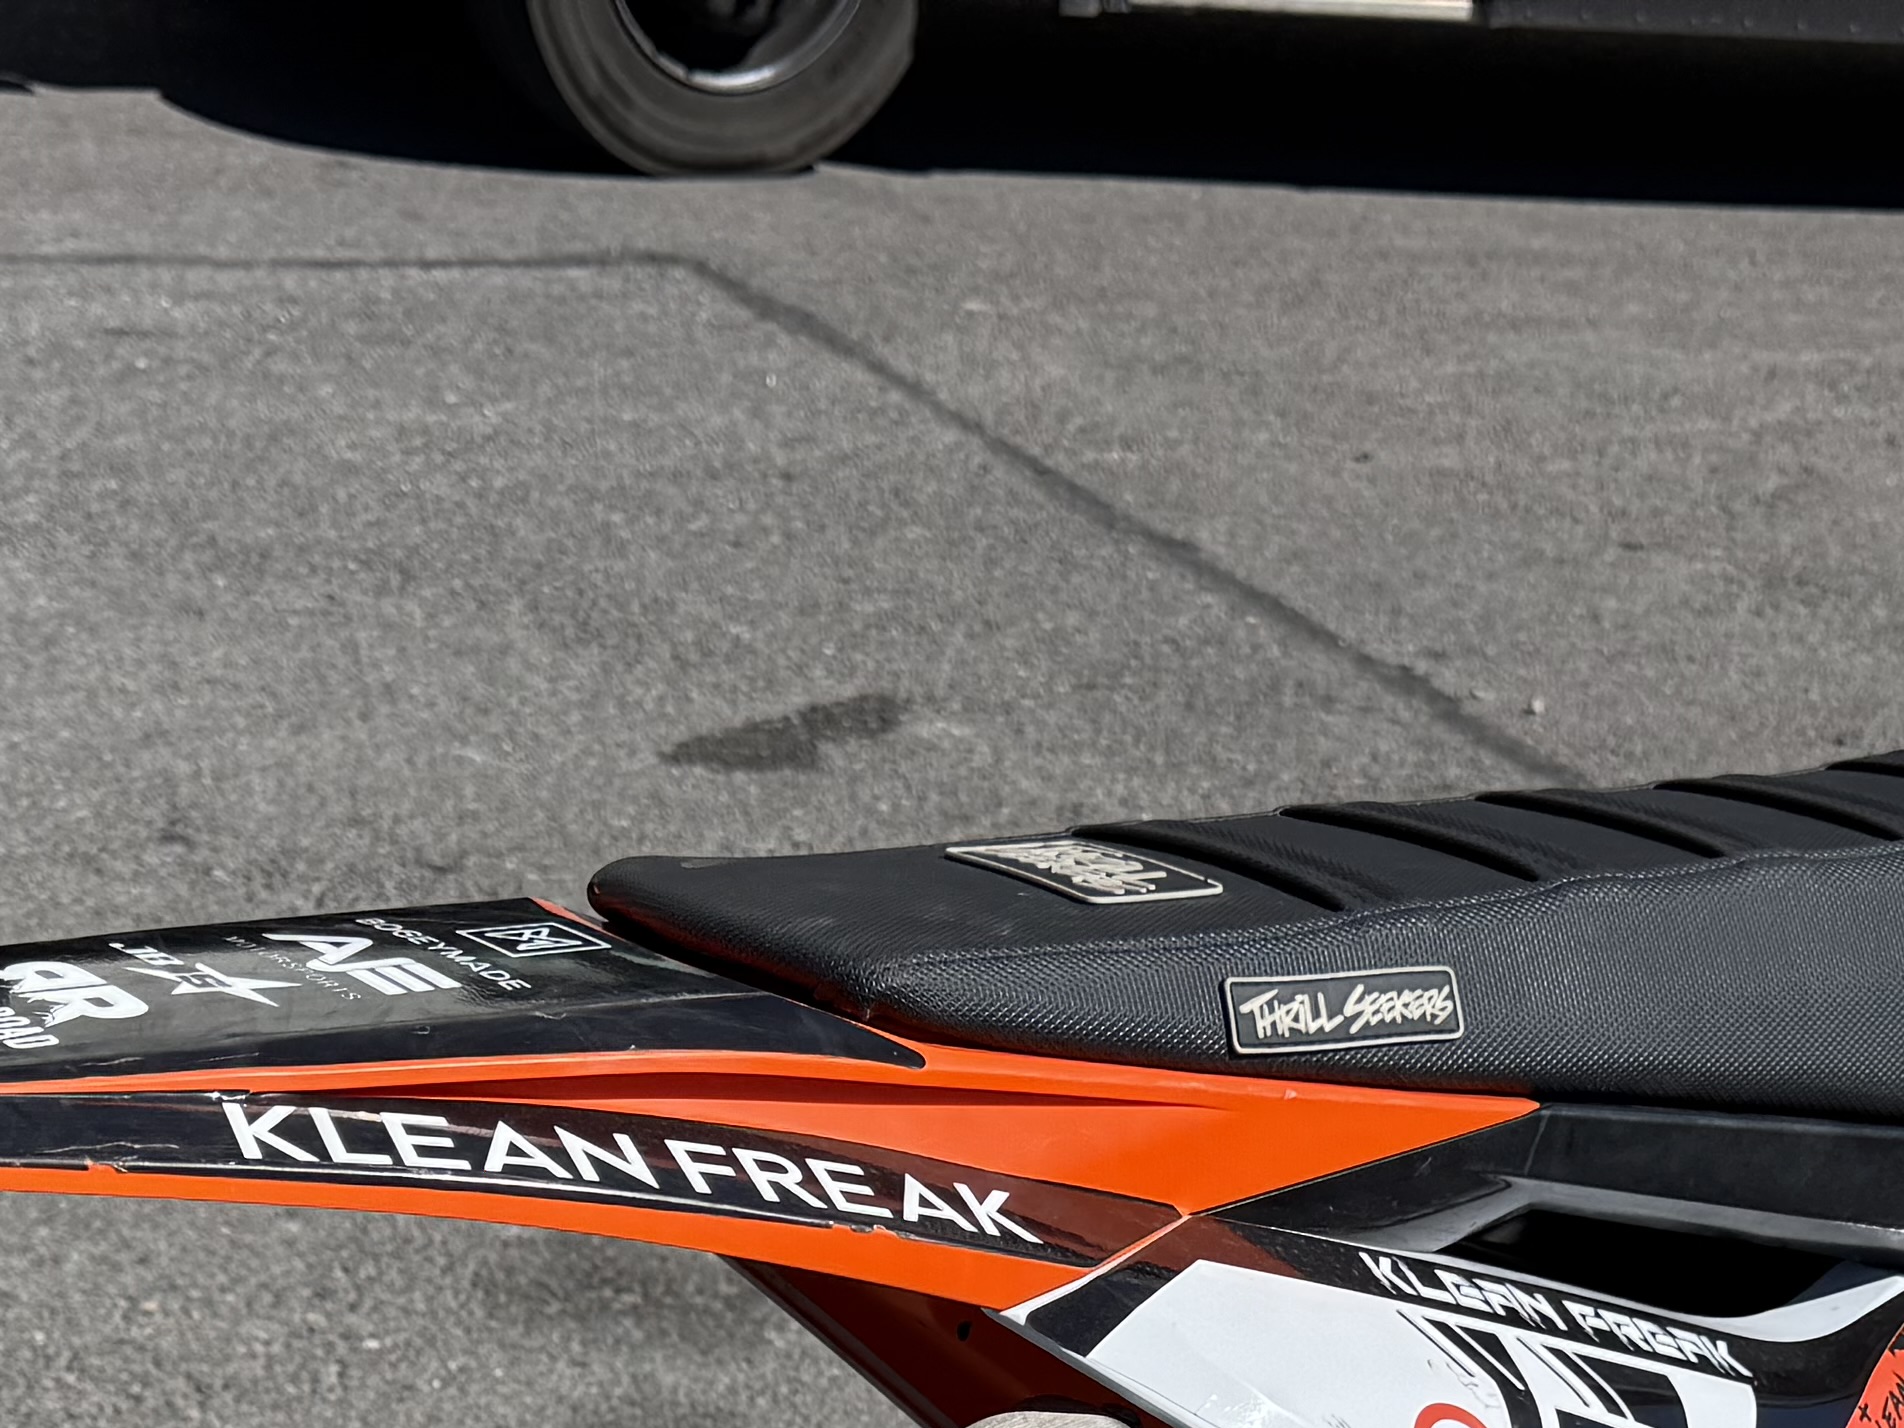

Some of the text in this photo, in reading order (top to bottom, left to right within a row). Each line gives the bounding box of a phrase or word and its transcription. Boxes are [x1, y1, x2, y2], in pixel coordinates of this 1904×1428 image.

[1239, 984, 1456, 1040] THRILL SEEKERS
[222, 1103, 1044, 1245] KLEAN FREAK
